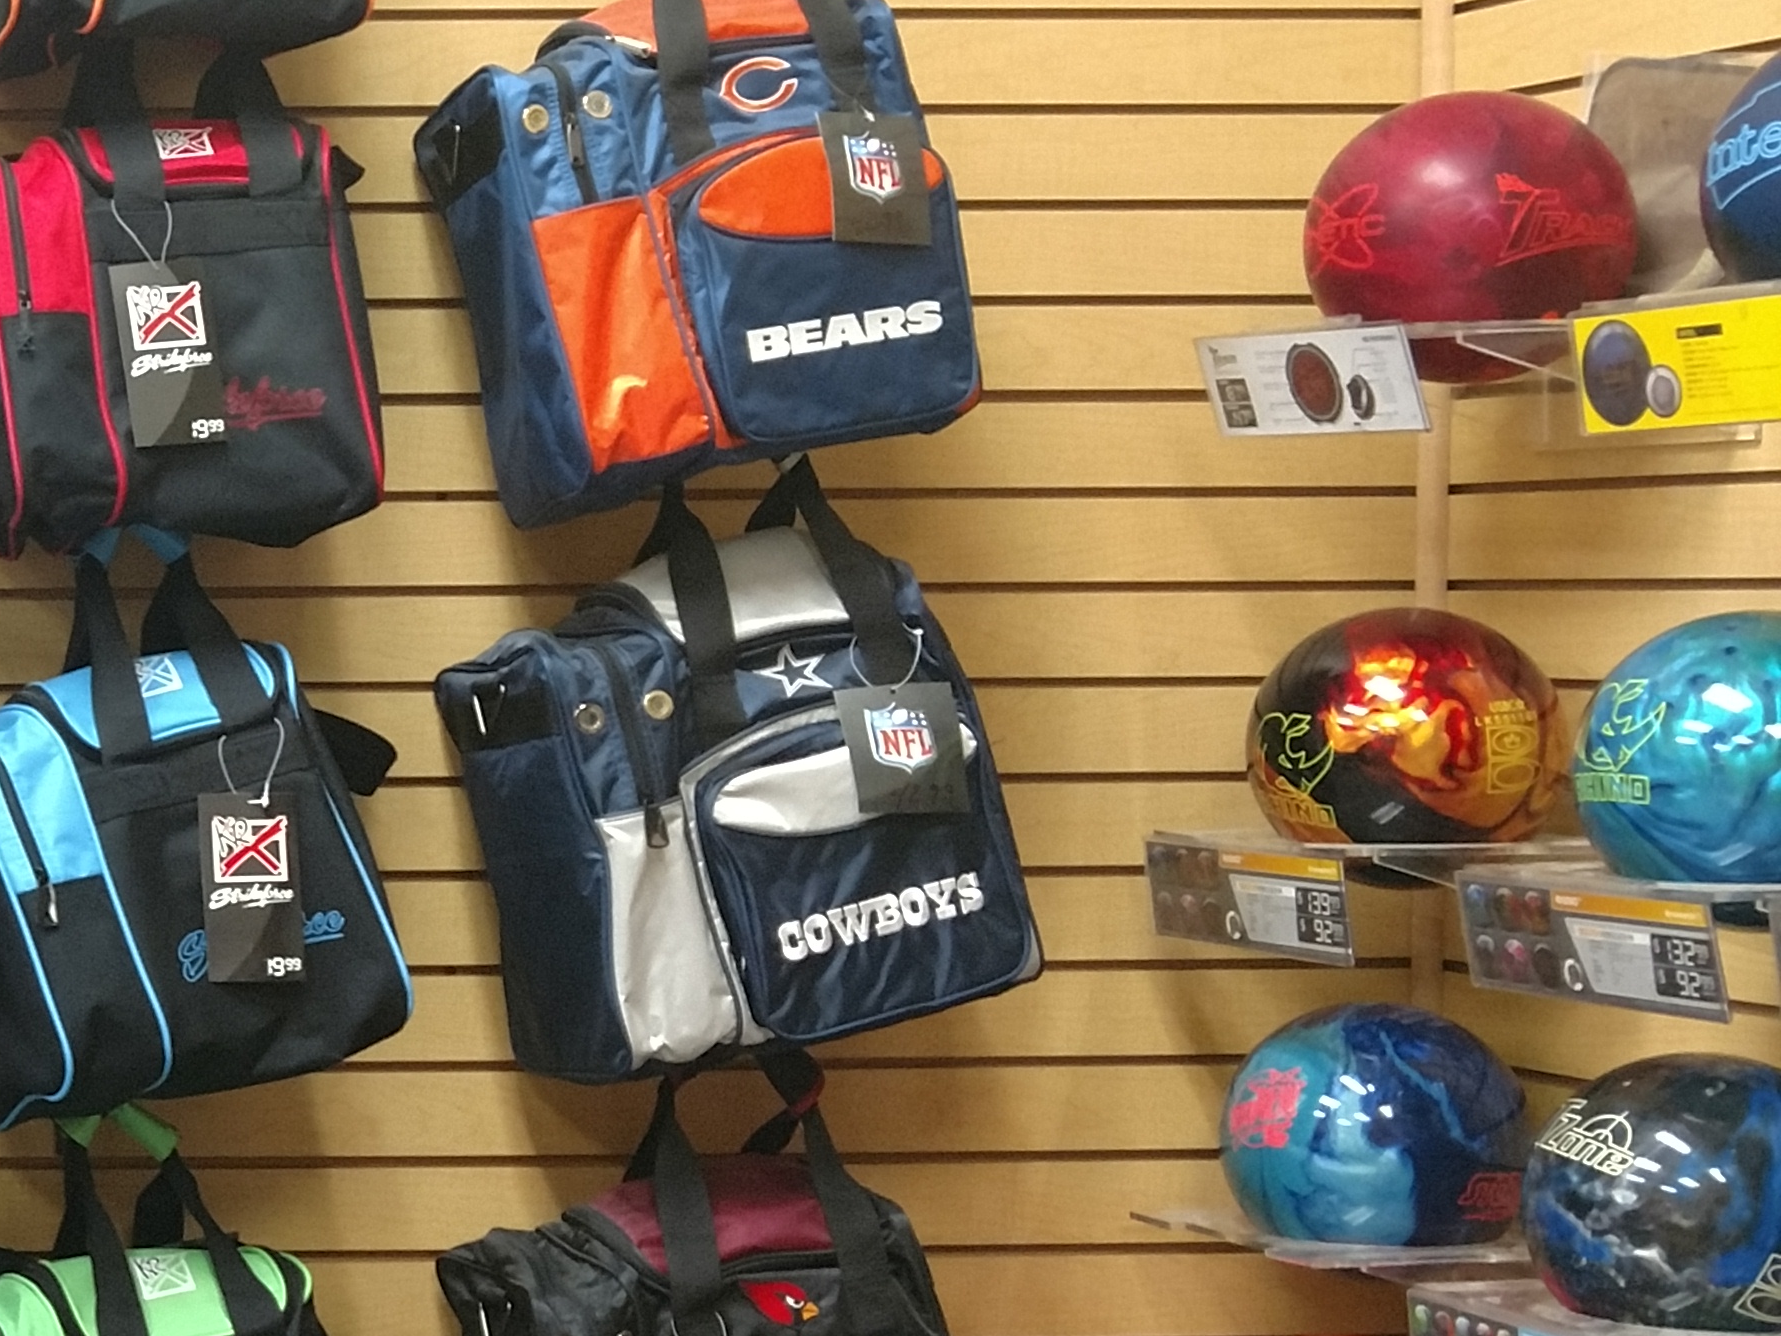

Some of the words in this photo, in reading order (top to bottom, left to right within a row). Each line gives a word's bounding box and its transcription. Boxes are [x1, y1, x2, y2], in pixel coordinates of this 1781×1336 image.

[857, 156, 901, 190] NFL
[746, 300, 943, 363] BEARS
[879, 727, 932, 757] NFL
[209, 884, 294, 909] Strikeforce
[778, 872, 985, 961] COWBOYS
